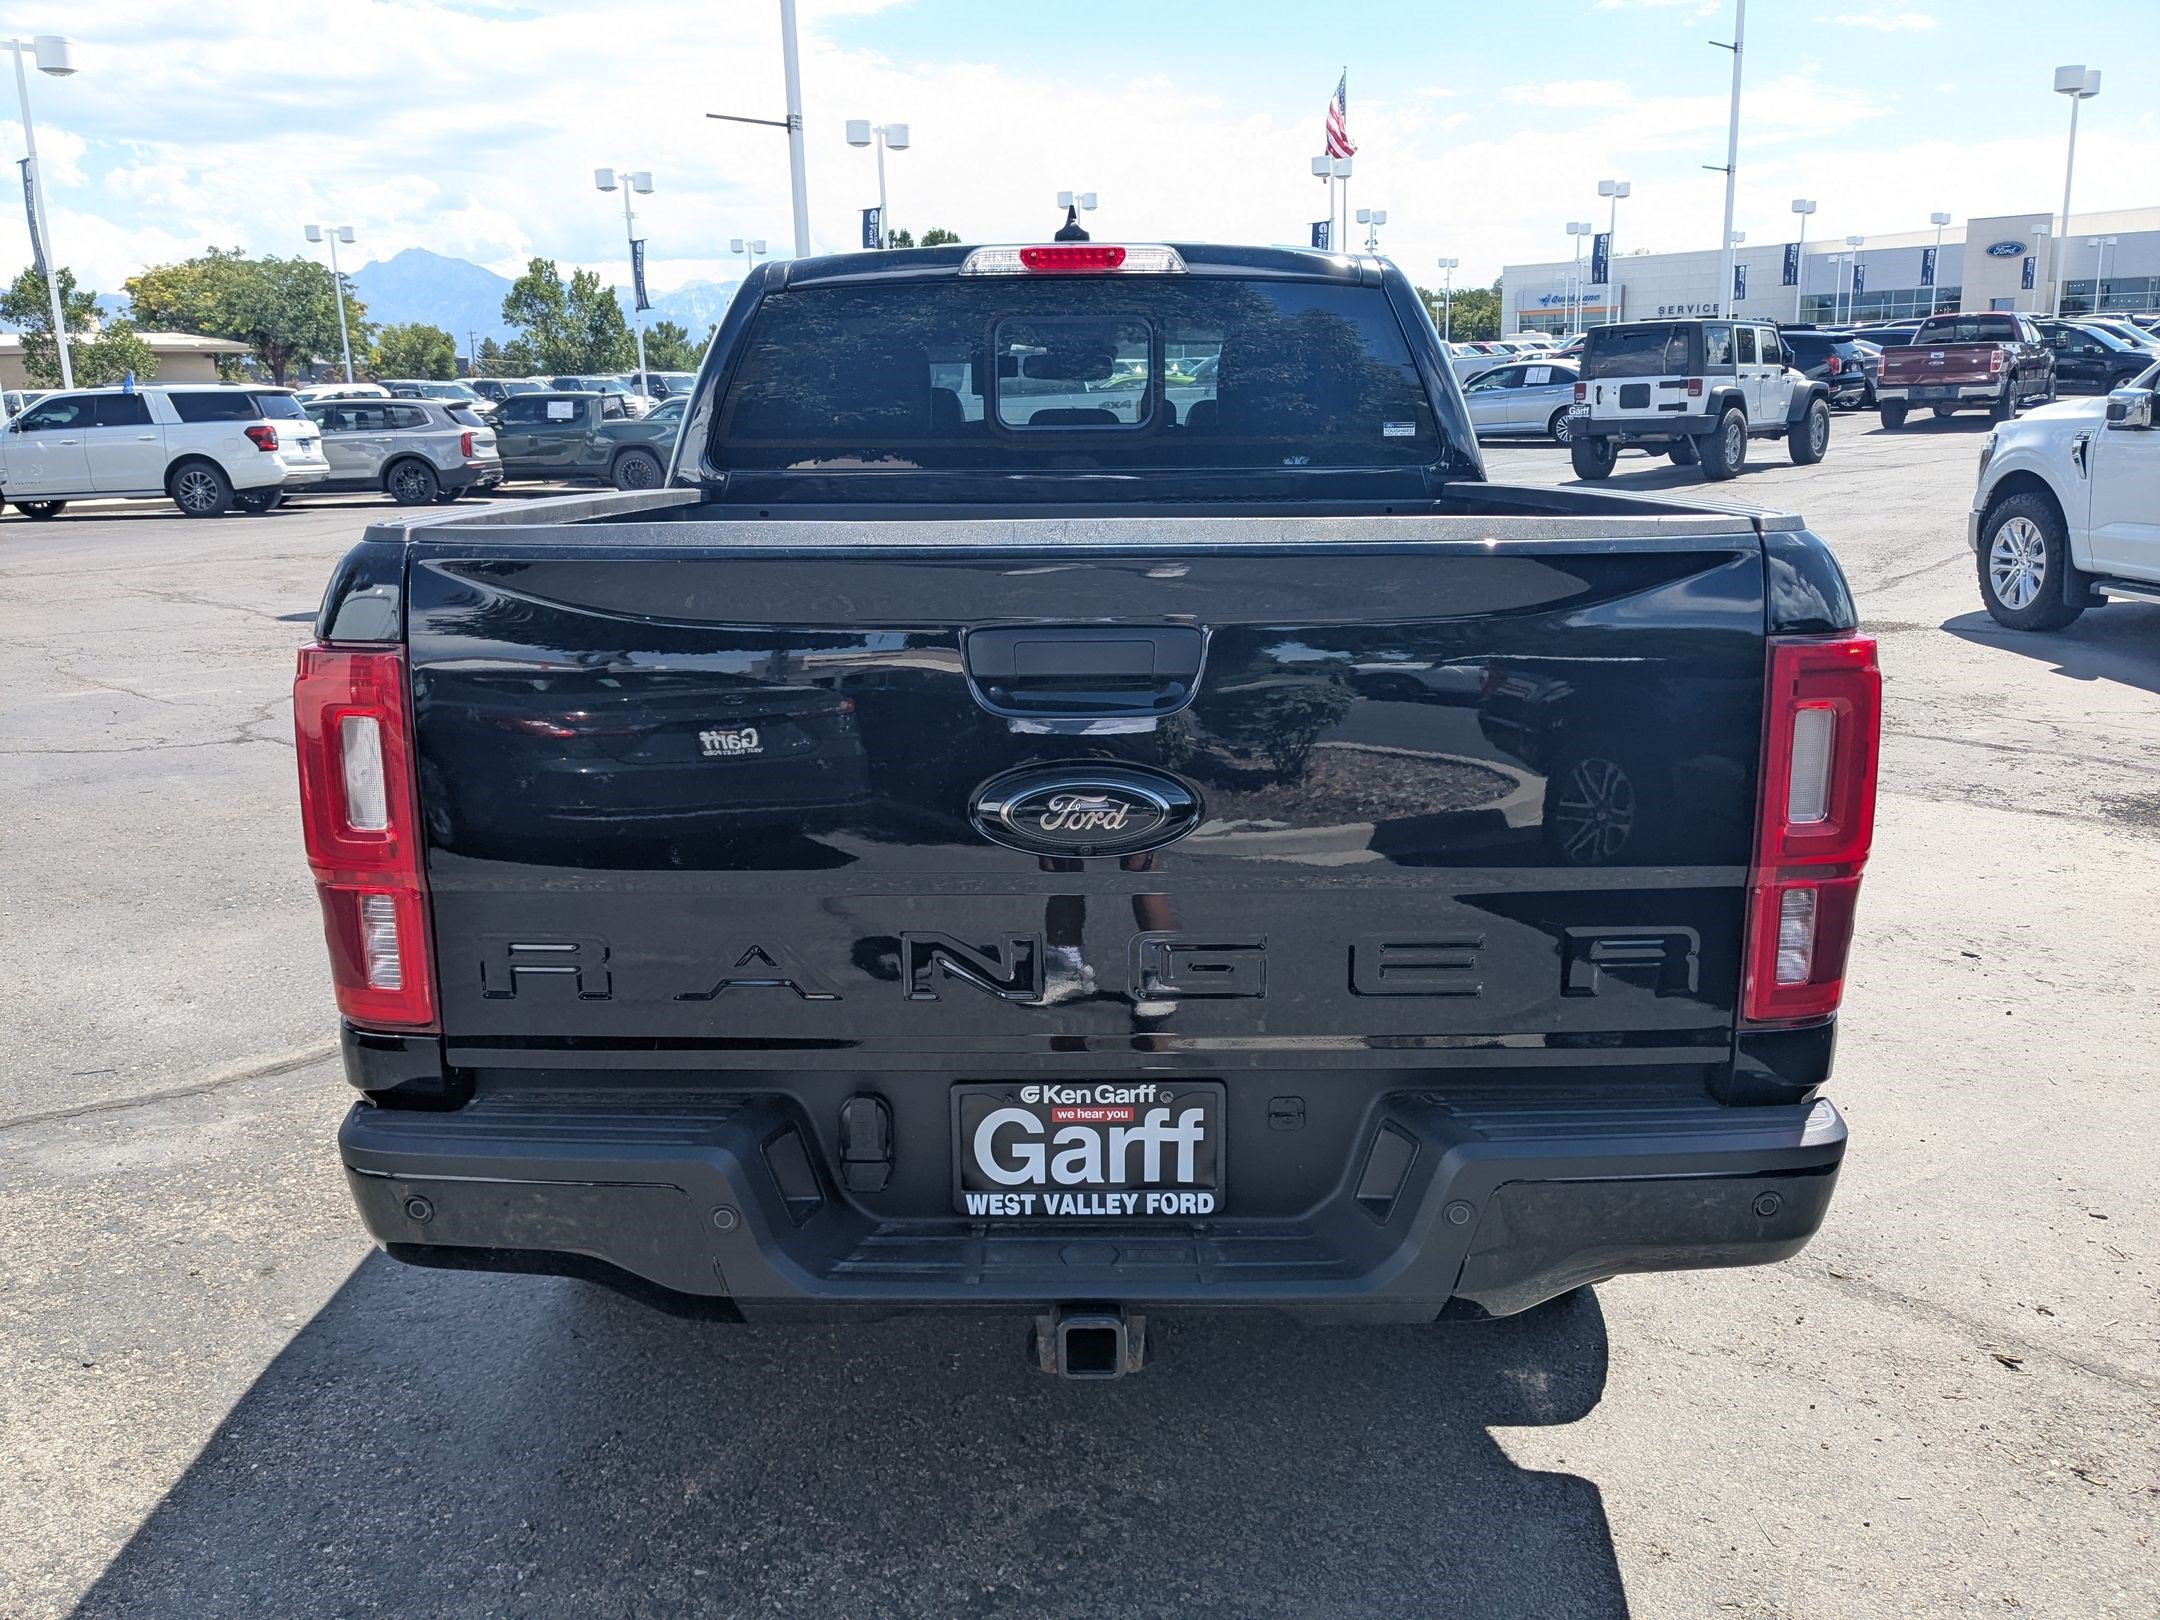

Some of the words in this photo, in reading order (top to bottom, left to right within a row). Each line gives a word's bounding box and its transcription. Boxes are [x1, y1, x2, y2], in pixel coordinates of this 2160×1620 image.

[1993, 245, 2017, 255] Ford
[1658, 303, 1720, 315] SERVICE
[1568, 406, 1590, 415] Garff
[1039, 793, 1131, 831] Ford
[479, 931, 1700, 1001] RANGER
[1043, 1084, 1091, 1104] Ken
[1094, 1084, 1156, 1104] Garff
[1057, 1109, 1075, 1119] we
[1077, 1108, 1105, 1119] hear
[1106, 1110, 1129, 1121] you
[973, 1107, 1205, 1186] Garff
[965, 1193, 1037, 1216] WEST
[1043, 1193, 1140, 1216] VALLEY
[1146, 1192, 1215, 1215] FORD
